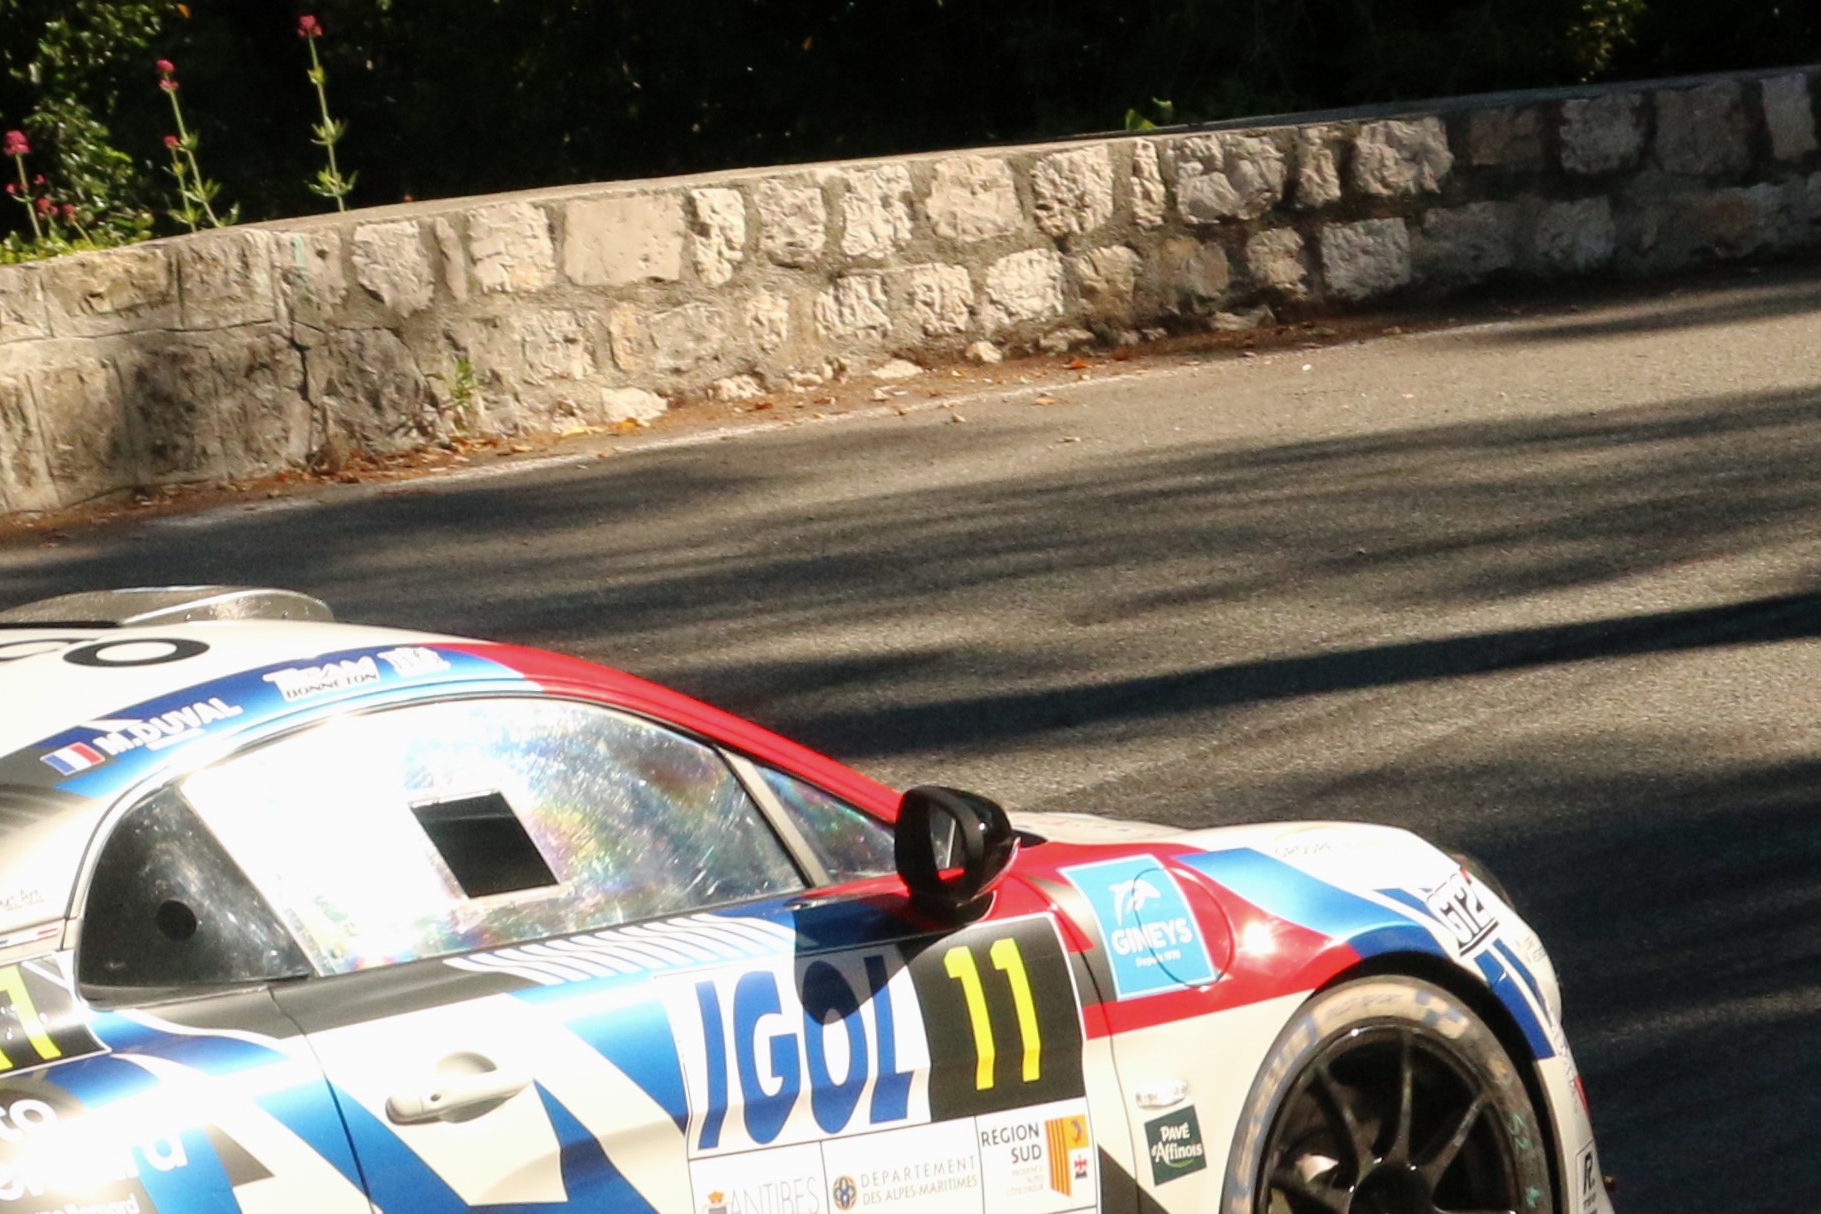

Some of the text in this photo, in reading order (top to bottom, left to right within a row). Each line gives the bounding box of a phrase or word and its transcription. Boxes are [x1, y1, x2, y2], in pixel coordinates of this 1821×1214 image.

[93, 697, 243, 757] M.DUVAL
[1111, 918, 1194, 955] GINEYS
[695, 937, 1041, 1151] IGOL 11
[1010, 1144, 1043, 1165] SUD
[863, 1174, 978, 1206] DES ALPES-MARITIMES
